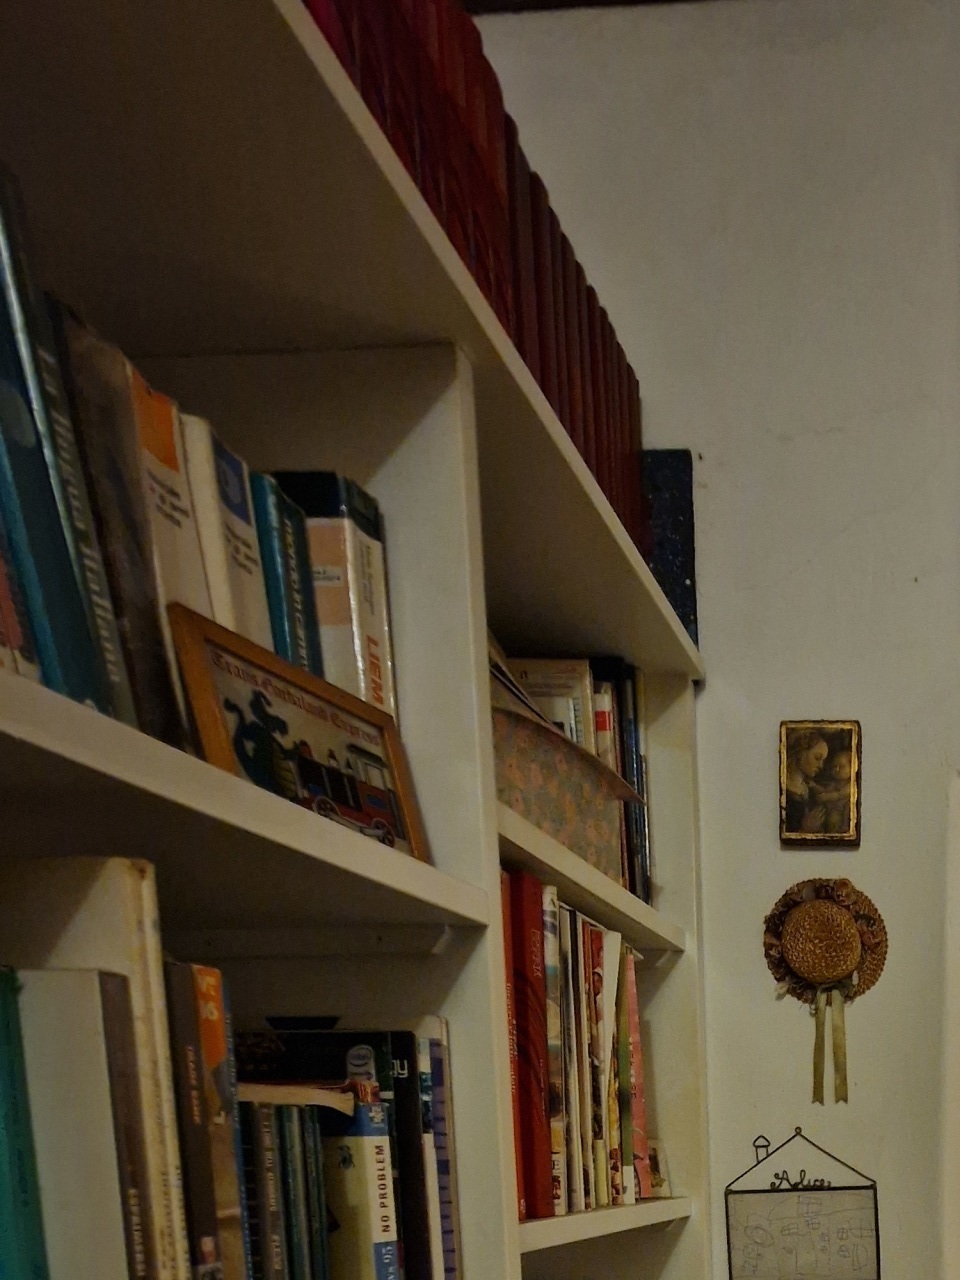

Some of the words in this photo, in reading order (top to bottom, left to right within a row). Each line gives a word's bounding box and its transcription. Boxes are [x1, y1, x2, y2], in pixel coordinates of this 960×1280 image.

[374, 1144, 389, 1209] PROBLEM
[769, 1169, 832, 1190] Alice
[380, 1215, 391, 1234] NO
[381, 1245, 393, 1264] 95
